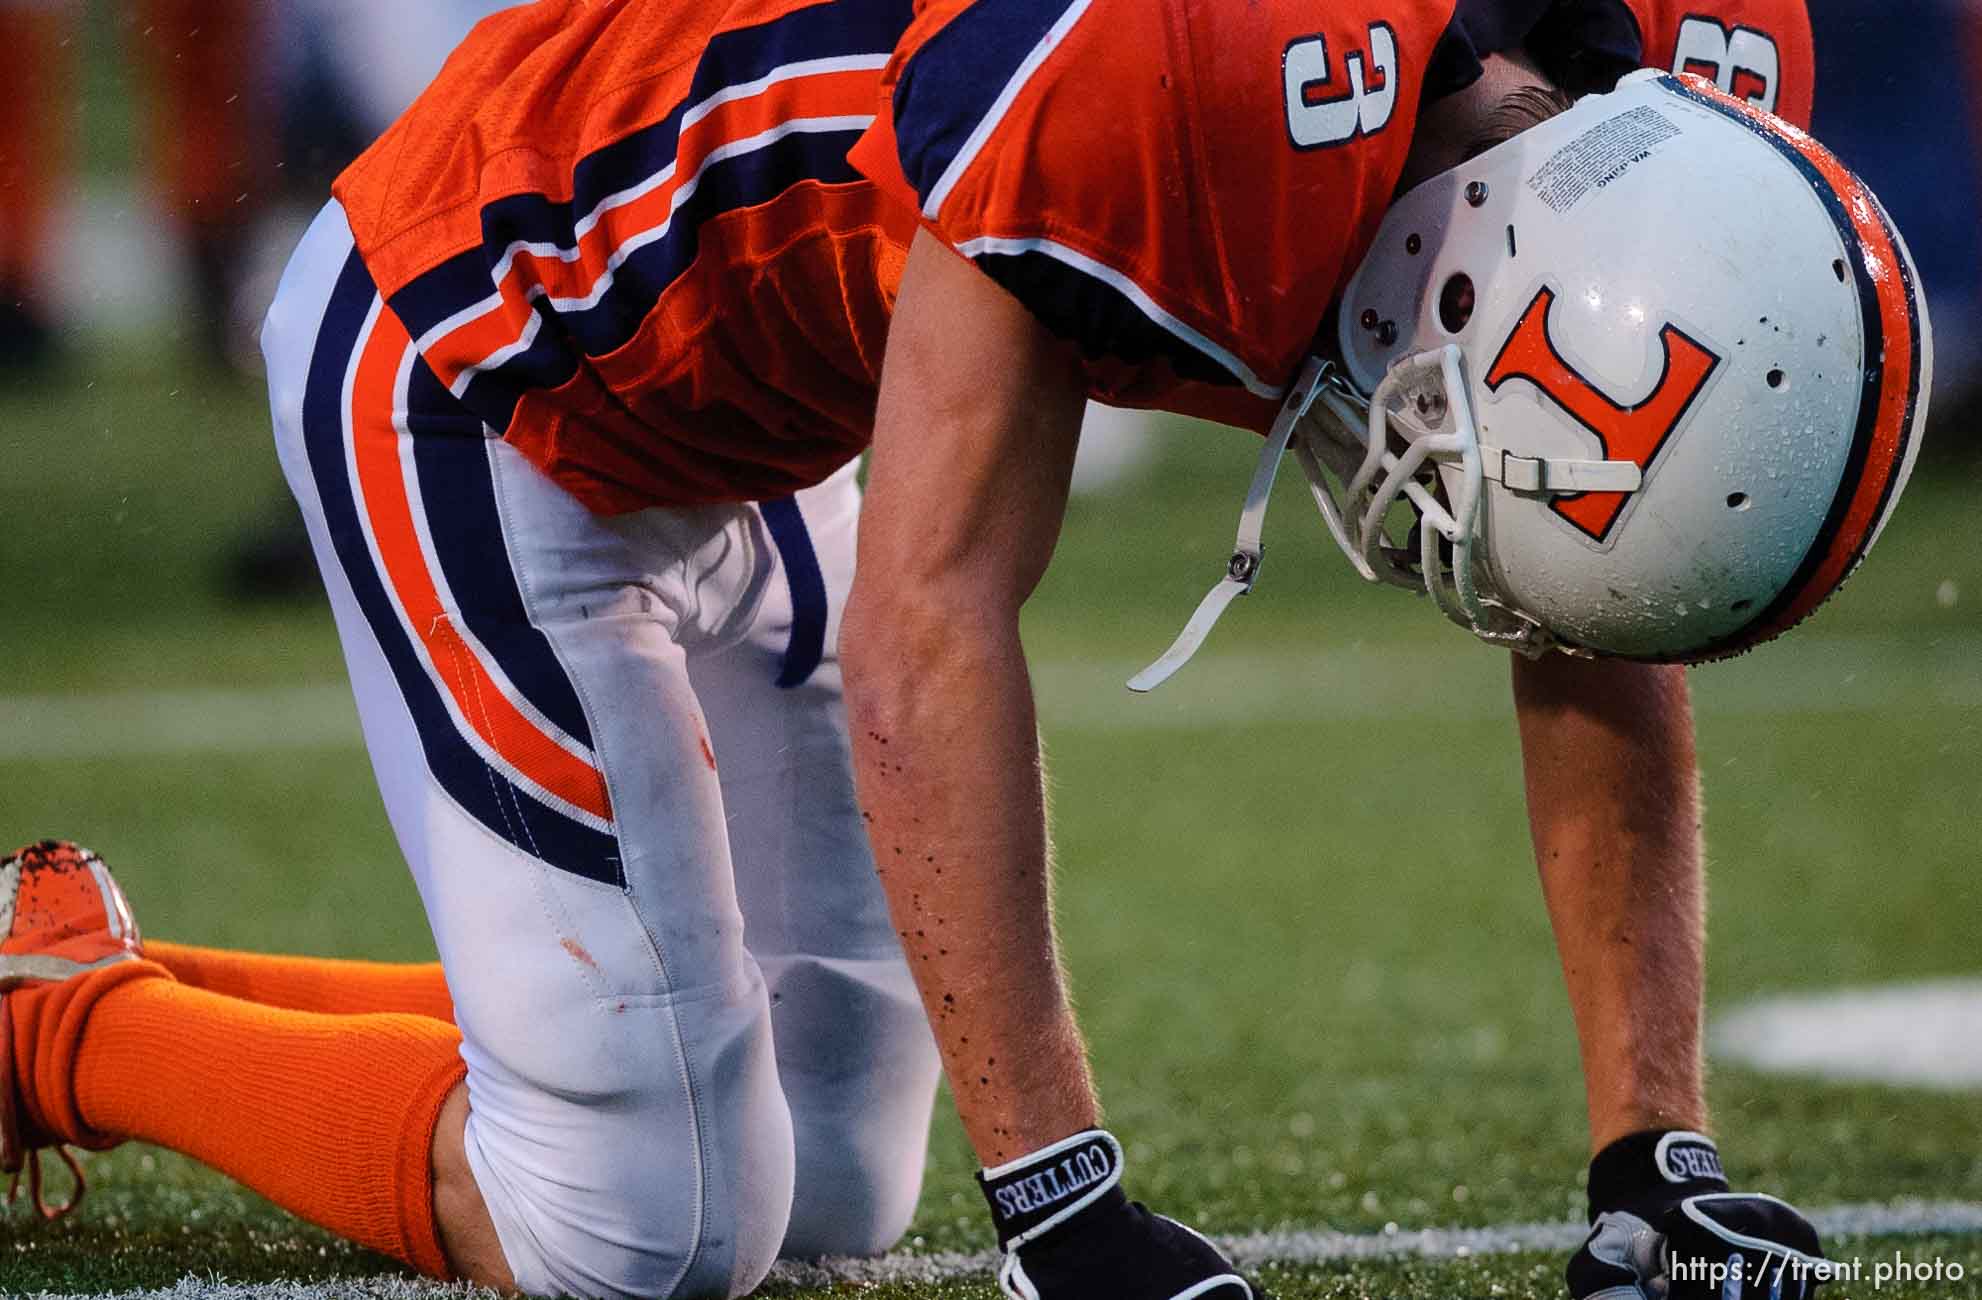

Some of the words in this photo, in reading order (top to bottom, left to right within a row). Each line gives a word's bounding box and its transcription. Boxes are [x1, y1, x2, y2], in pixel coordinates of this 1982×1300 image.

[1282, 20, 1398, 150] 3
[1484, 284, 1722, 544] L
[995, 1145, 1110, 1220] CUTTERS
